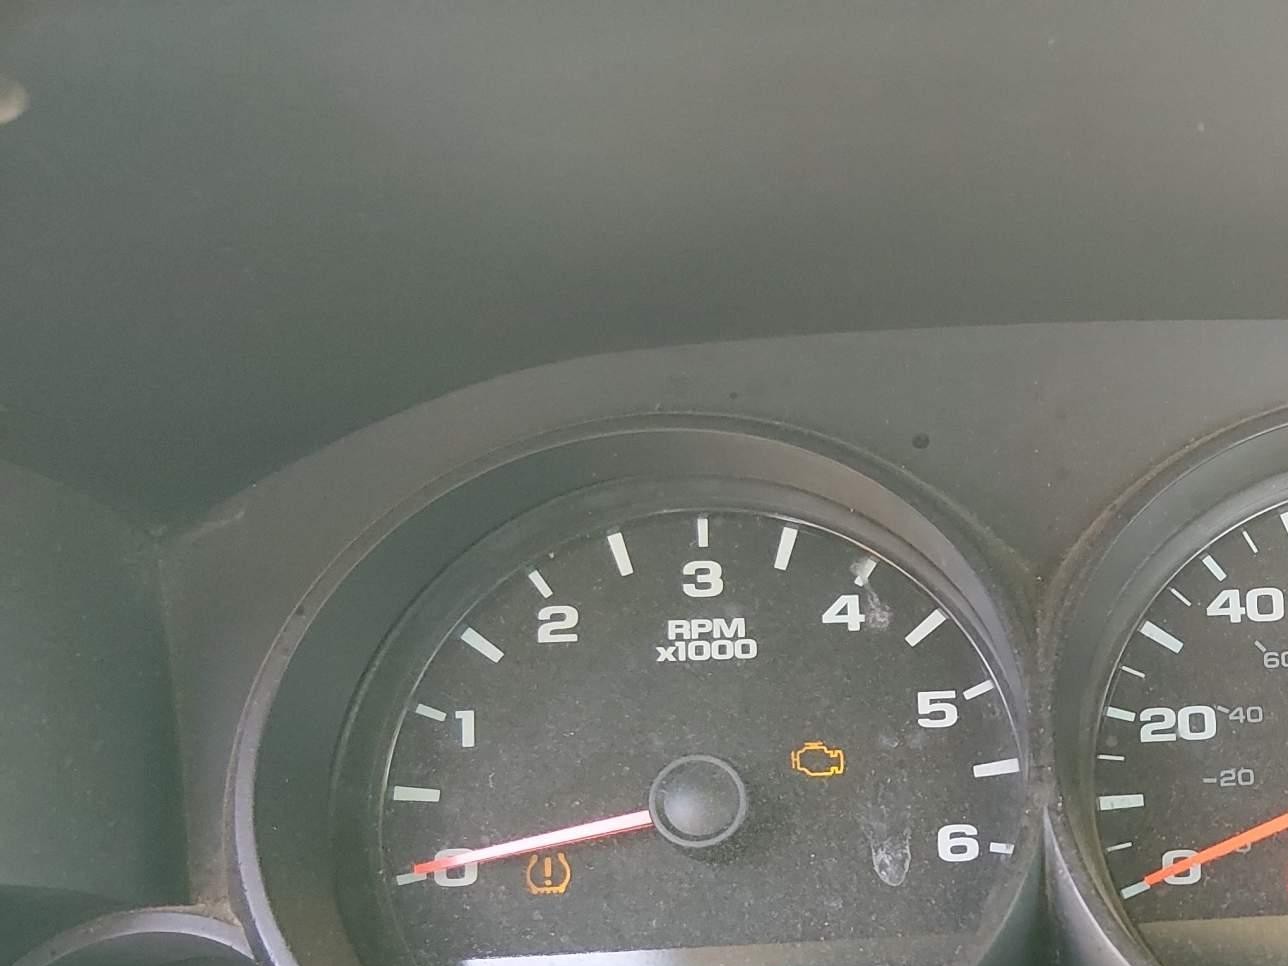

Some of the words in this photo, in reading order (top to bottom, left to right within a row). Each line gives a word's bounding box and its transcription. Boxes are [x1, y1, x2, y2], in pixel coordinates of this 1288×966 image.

[682, 560, 724, 598] 3
[537, 605, 579, 643] 2
[821, 594, 866, 631] 4
[1206, 587, 1284, 624] 40
[667, 618, 746, 640] RPM
[656, 639, 758, 661] x1000
[917, 691, 958, 728] 5
[1140, 705, 1218, 743] 20
[1228, 705, 1264, 724] 40
[455, 710, 476, 747] 1
[1218, 768, 1255, 787] 20
[937, 824, 979, 861] 6
[434, 848, 478, 886] 0
[1162, 850, 1201, 885] 0
